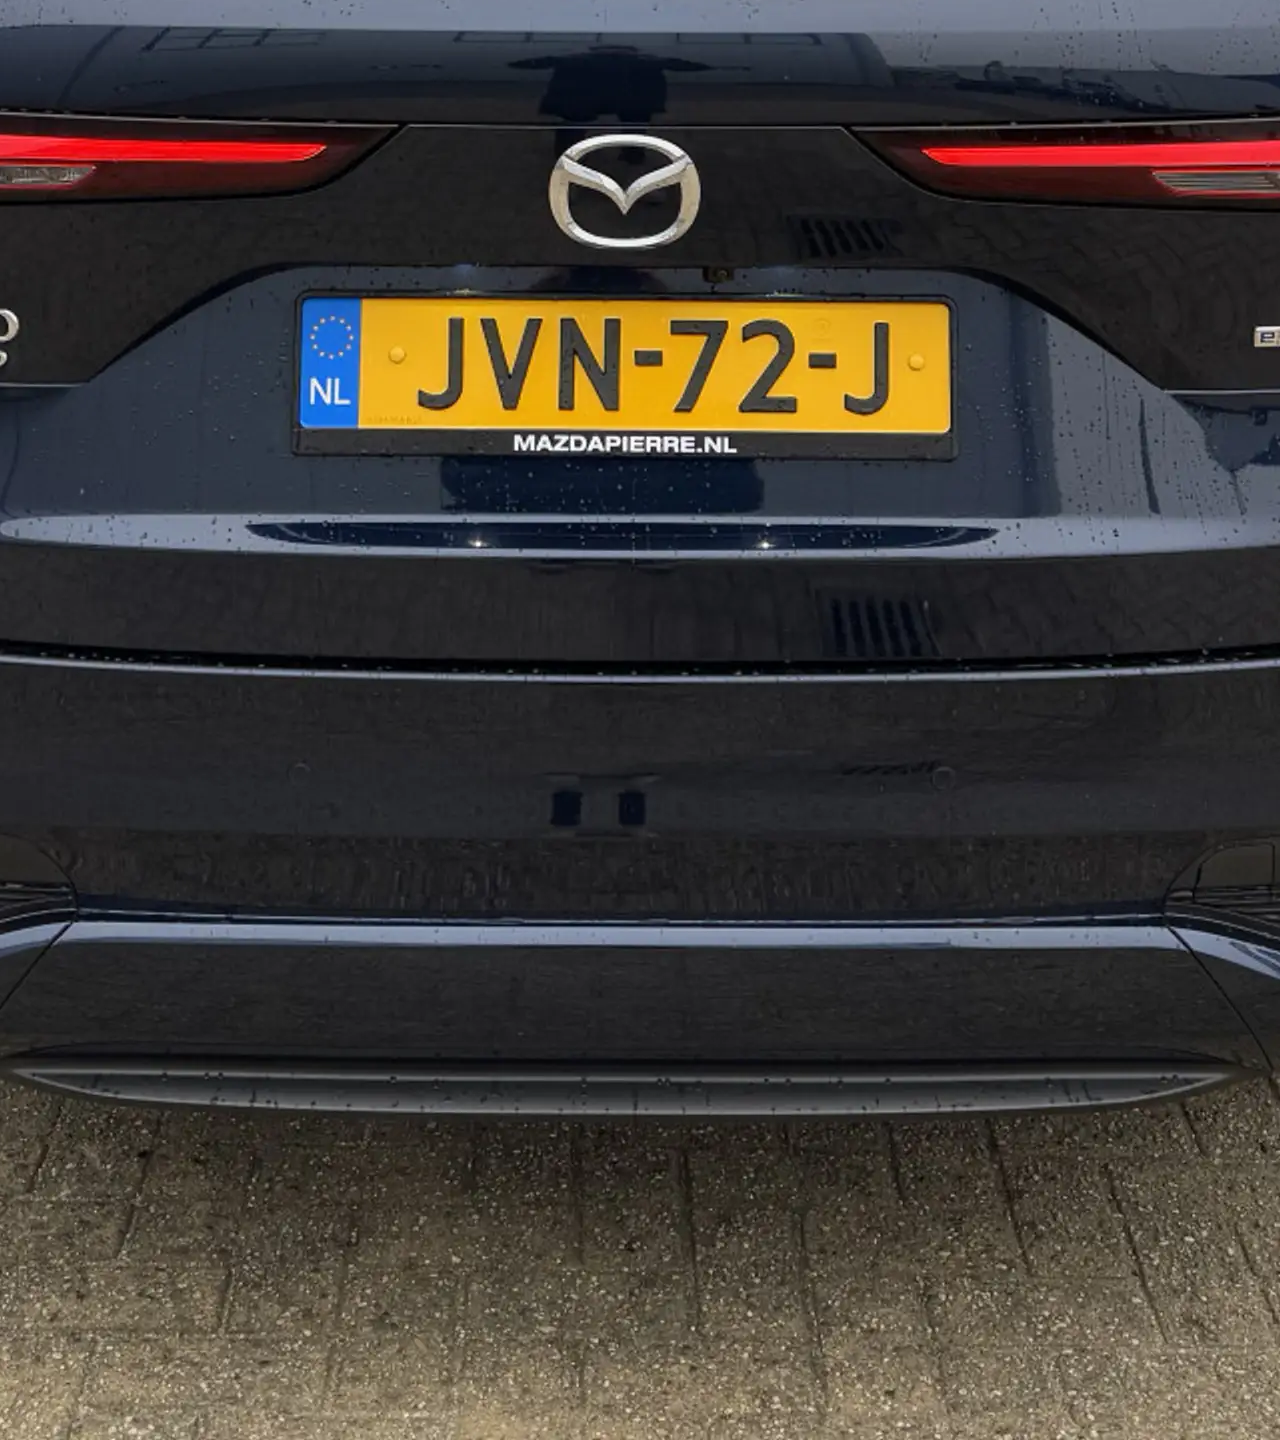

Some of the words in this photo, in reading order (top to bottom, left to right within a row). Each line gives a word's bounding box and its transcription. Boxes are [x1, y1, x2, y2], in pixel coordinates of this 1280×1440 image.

[417, 317, 889, 414] JVN-72-J
[310, 377, 350, 405] NL
[513, 434, 737, 453] MAZDAPIERRE.NL
